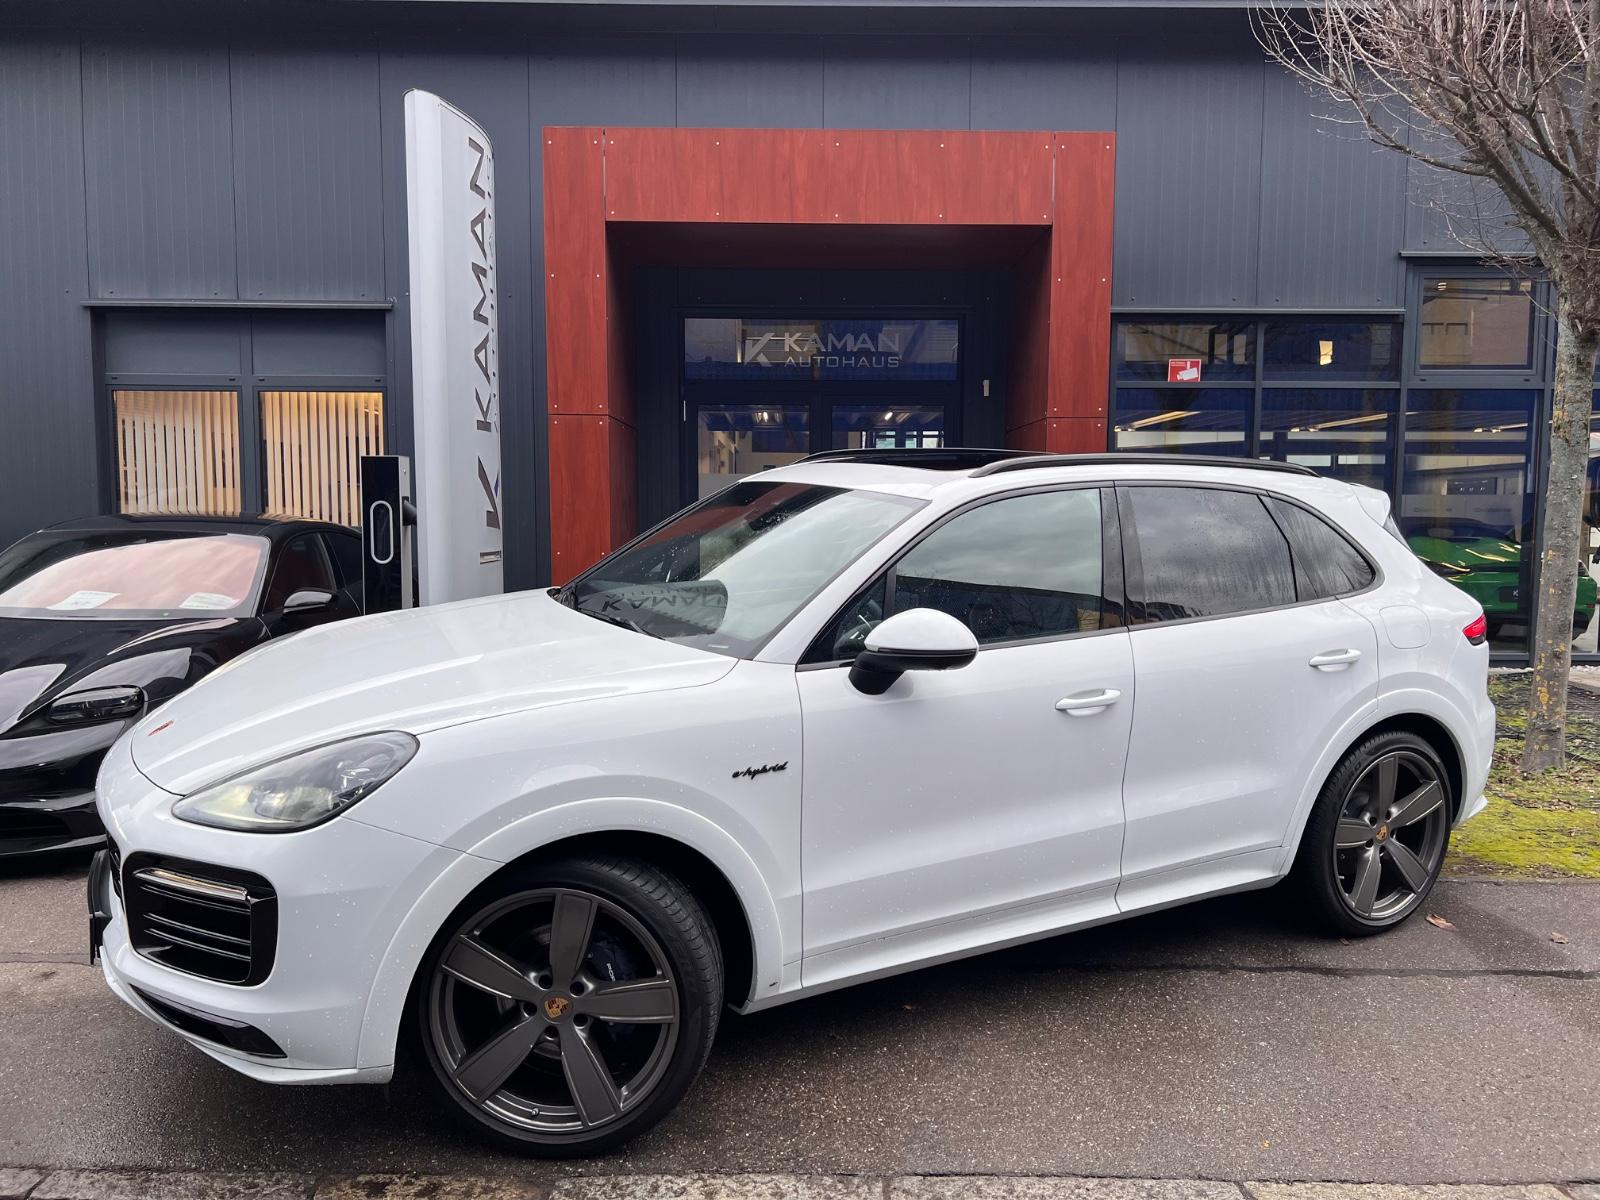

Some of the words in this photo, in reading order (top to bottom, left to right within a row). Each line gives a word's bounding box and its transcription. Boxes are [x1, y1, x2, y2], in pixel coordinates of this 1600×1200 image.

[468, 136, 492, 432] KAMAN
[784, 332, 901, 352] KAMAN
[784, 356, 900, 368] AUTOHAUS
[731, 760, 789, 780] e-hybrid
